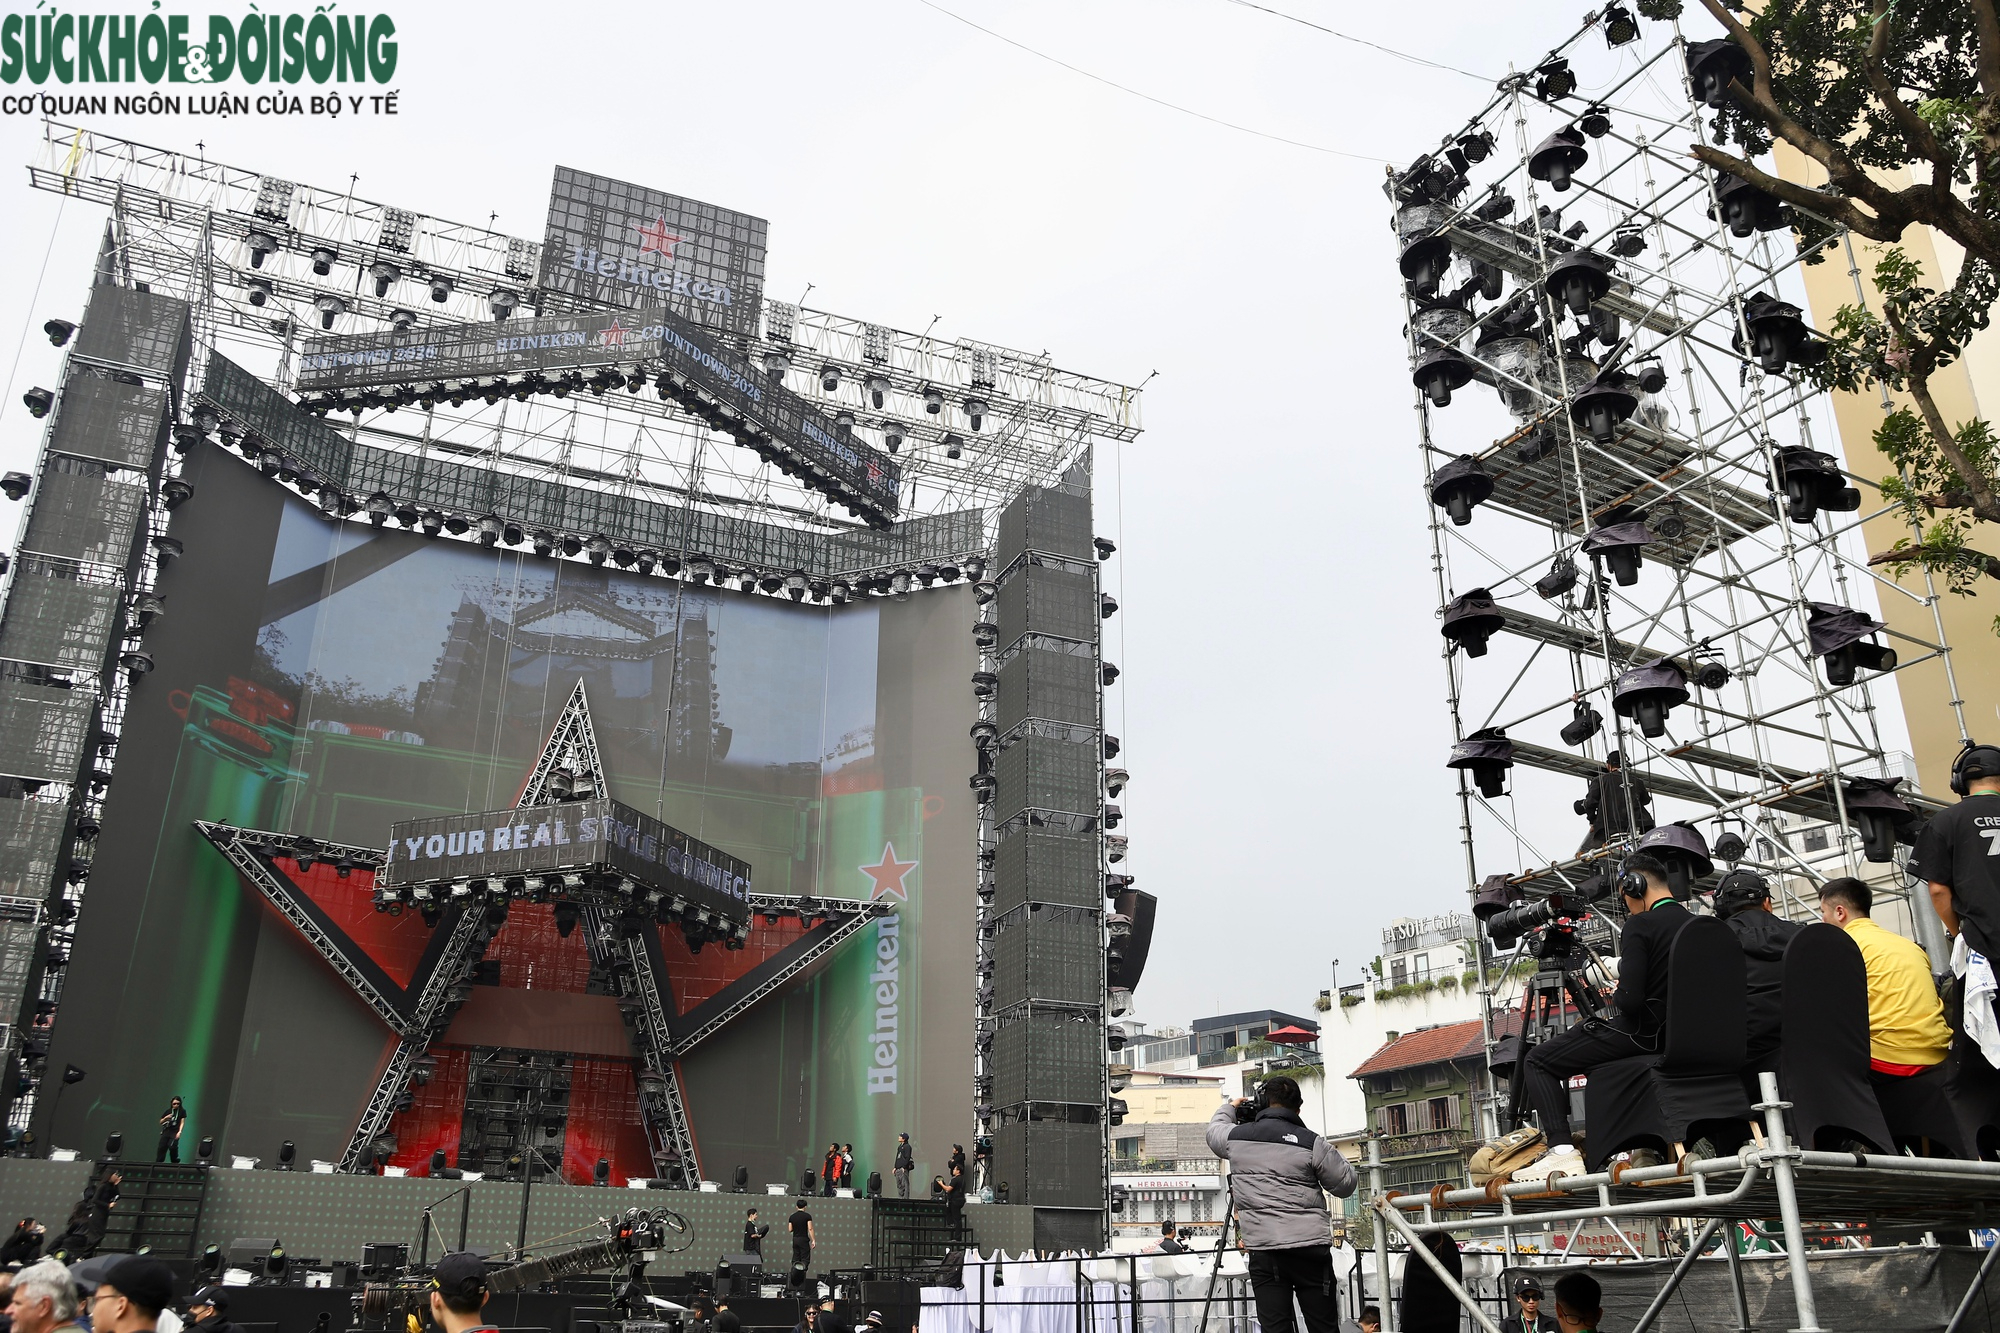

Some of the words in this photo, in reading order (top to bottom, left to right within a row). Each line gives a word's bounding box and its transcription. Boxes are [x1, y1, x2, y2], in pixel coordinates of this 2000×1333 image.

[570, 246, 733, 307] Heineken
[496, 331, 588, 351] HEINEKEN
[640, 324, 732, 382] COUNTDOWN
[732, 374, 763, 402] 2026
[801, 420, 860, 468] HEINEKEN
[405, 830, 487, 861] YOUR
[493, 820, 571, 852] REAL
[578, 815, 659, 865] STYLE
[867, 912, 900, 1096] Heineken
[1576, 1233, 1623, 1246] Dragon
